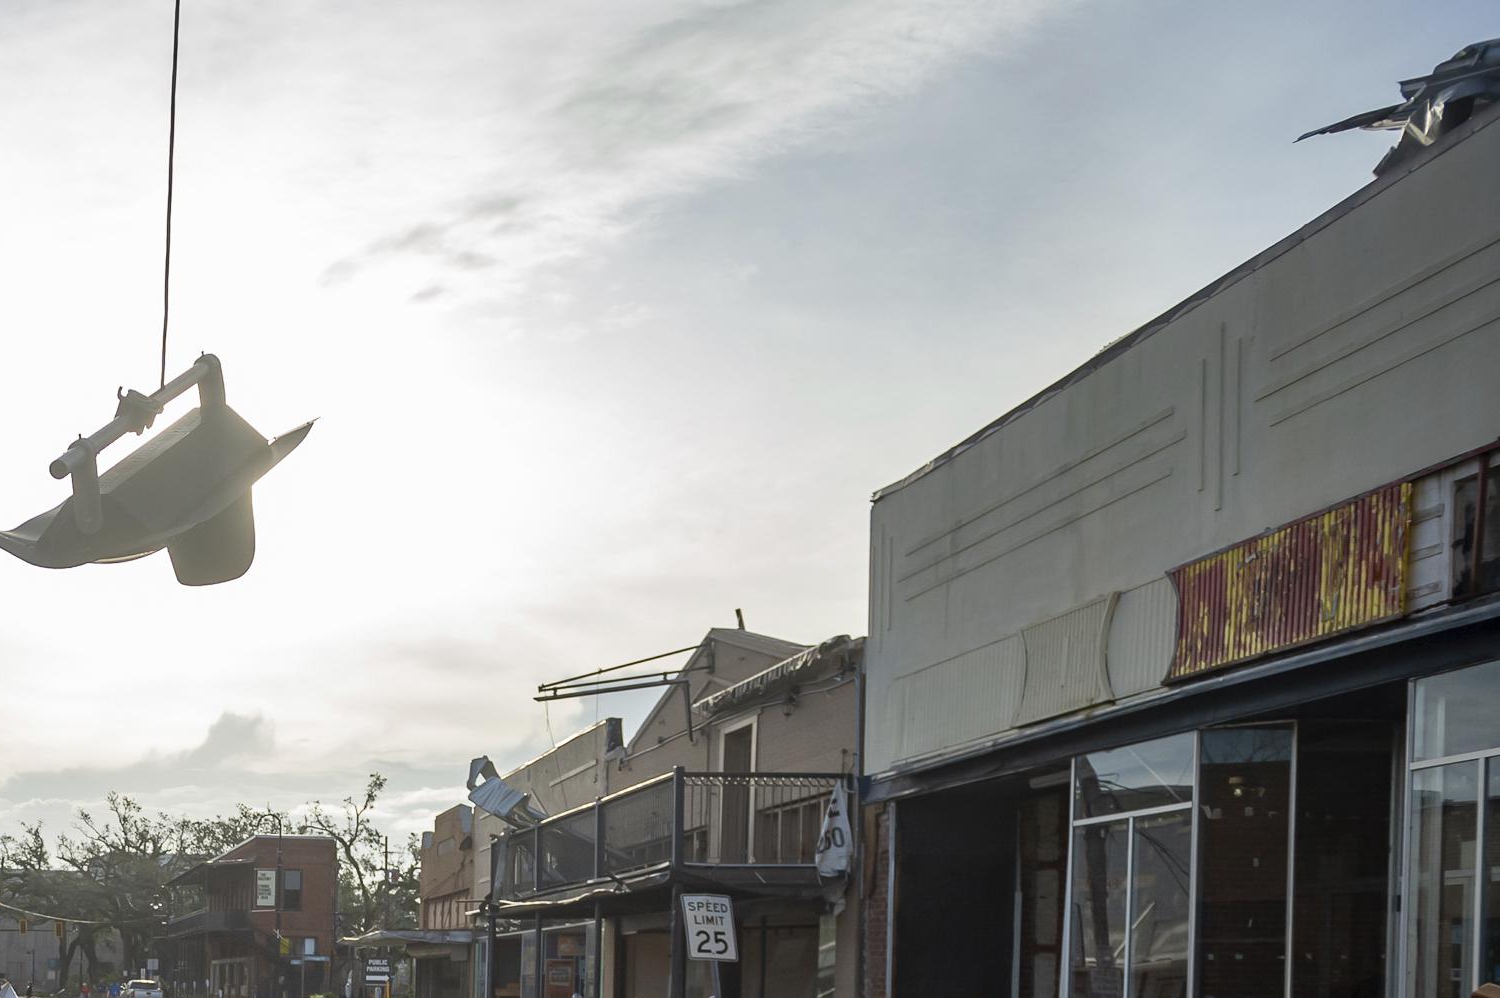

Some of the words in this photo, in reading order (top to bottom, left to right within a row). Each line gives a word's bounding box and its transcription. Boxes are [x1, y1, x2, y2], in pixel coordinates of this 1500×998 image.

[688, 901, 728, 913] SPEED
[694, 915, 724, 926] LIMIT
[696, 930, 728, 955] 25
